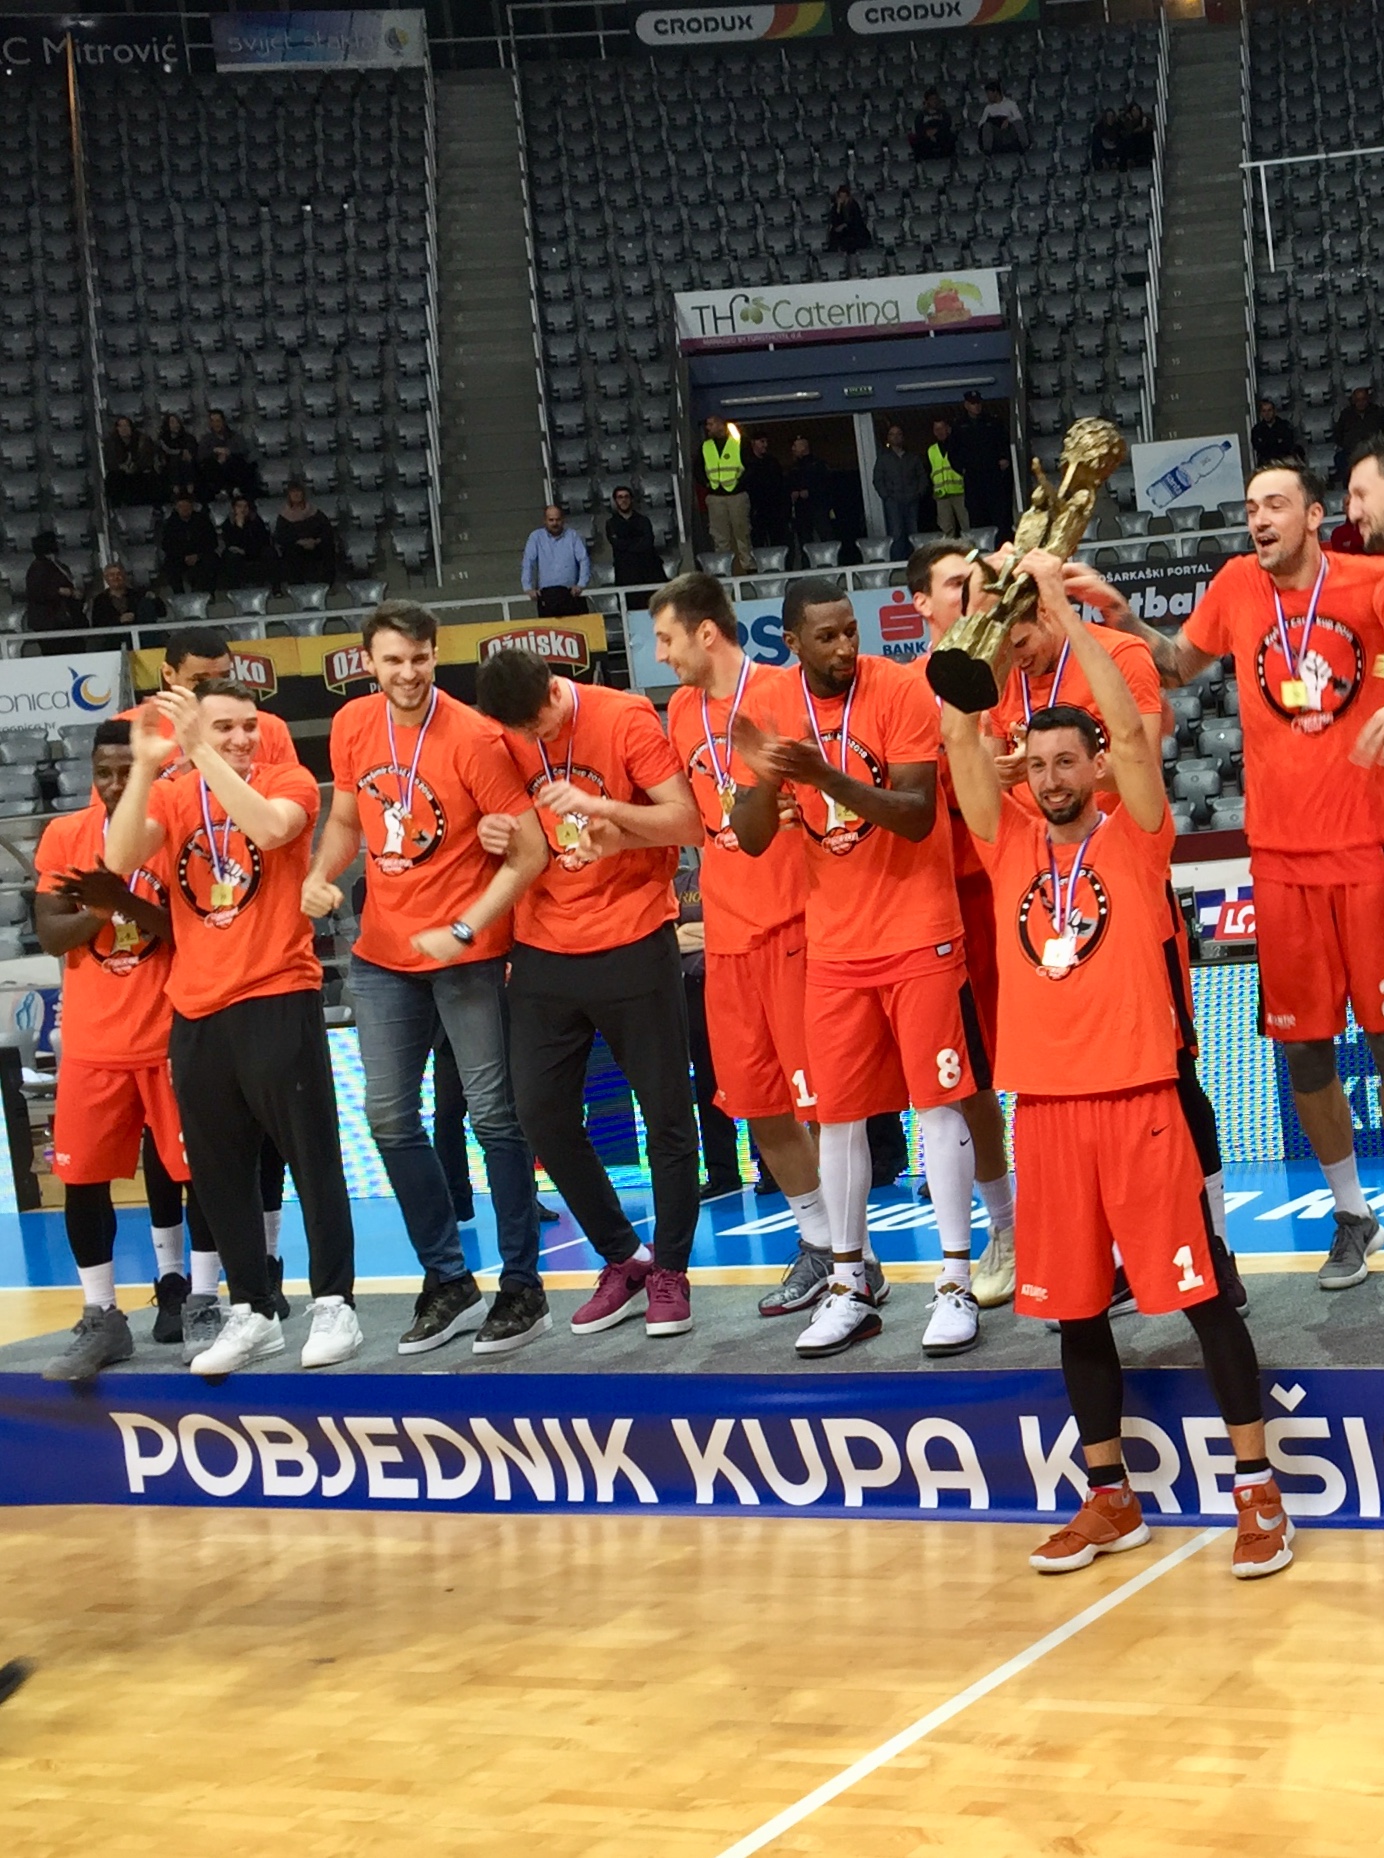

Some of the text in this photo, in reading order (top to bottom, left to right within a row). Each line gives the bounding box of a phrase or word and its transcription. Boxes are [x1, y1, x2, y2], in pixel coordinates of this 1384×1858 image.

[653, 15, 754, 37] CRODUX
[864, 2, 962, 24] CRODUX
[771, 294, 901, 331] Catering
[1166, 563, 1213, 578] PORTAL
[881, 641, 927, 657] BANK
[936, 1047, 961, 1089] 8
[1172, 1244, 1205, 1293] 1
[109, 1411, 660, 1504] POBJEDNIK
[670, 1415, 991, 1512] KUPA
